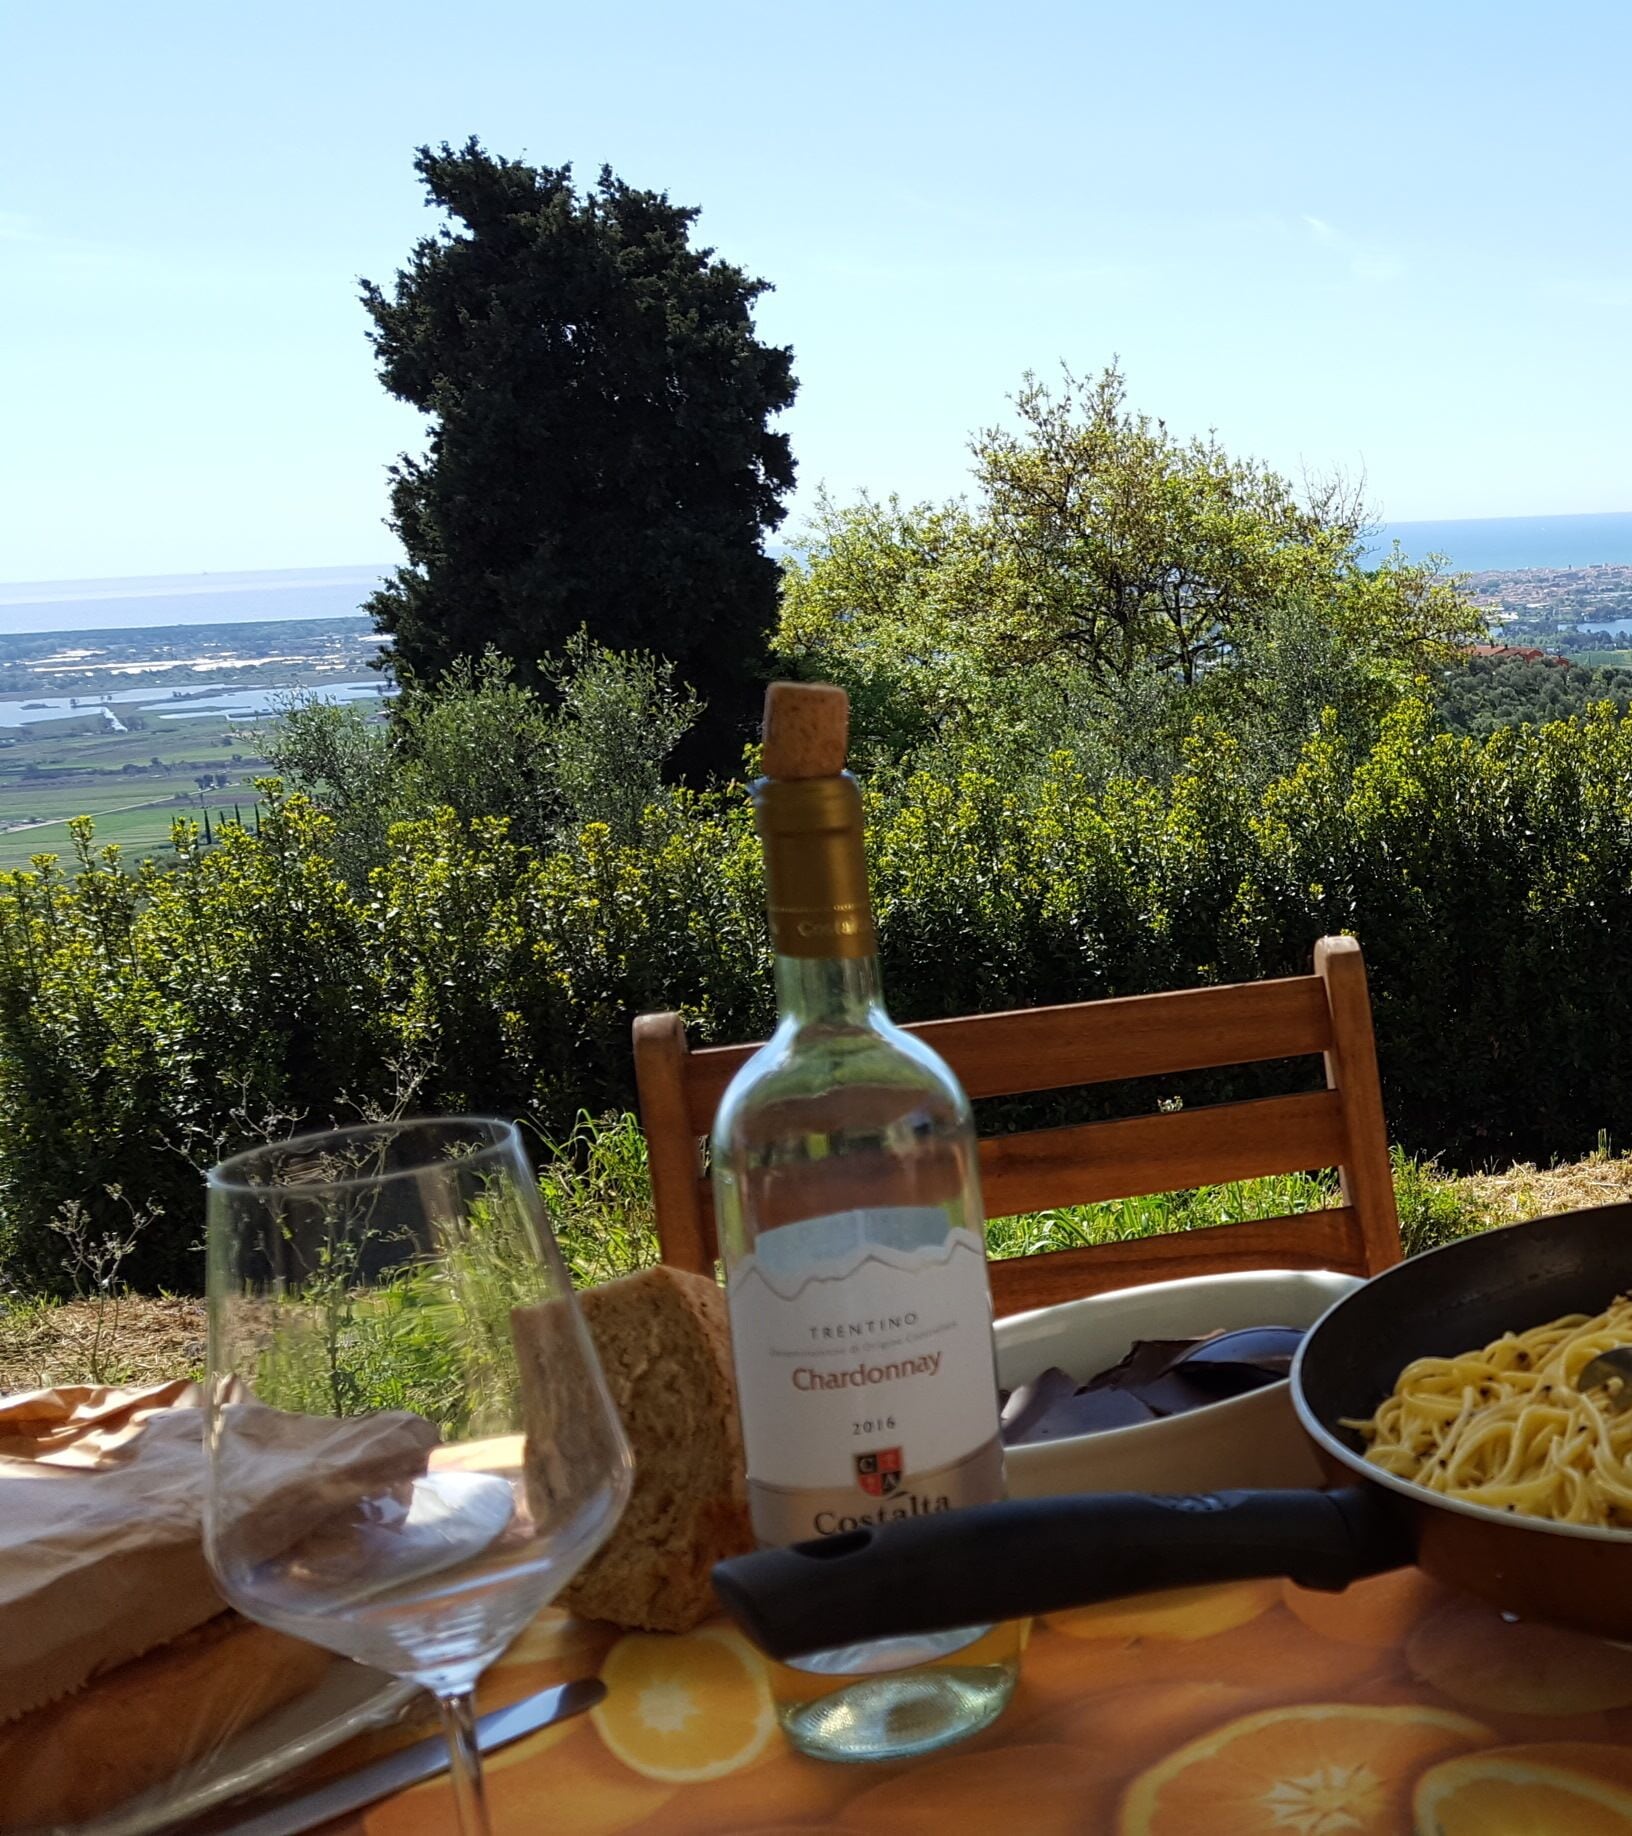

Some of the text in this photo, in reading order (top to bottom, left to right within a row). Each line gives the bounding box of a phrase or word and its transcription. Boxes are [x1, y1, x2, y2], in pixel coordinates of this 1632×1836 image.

[809, 1312, 919, 1341] TRENTINO
[792, 1350, 943, 1392] Chardonnay
[852, 1415, 897, 1435] 2016
[813, 1493, 950, 1536] Costalta
